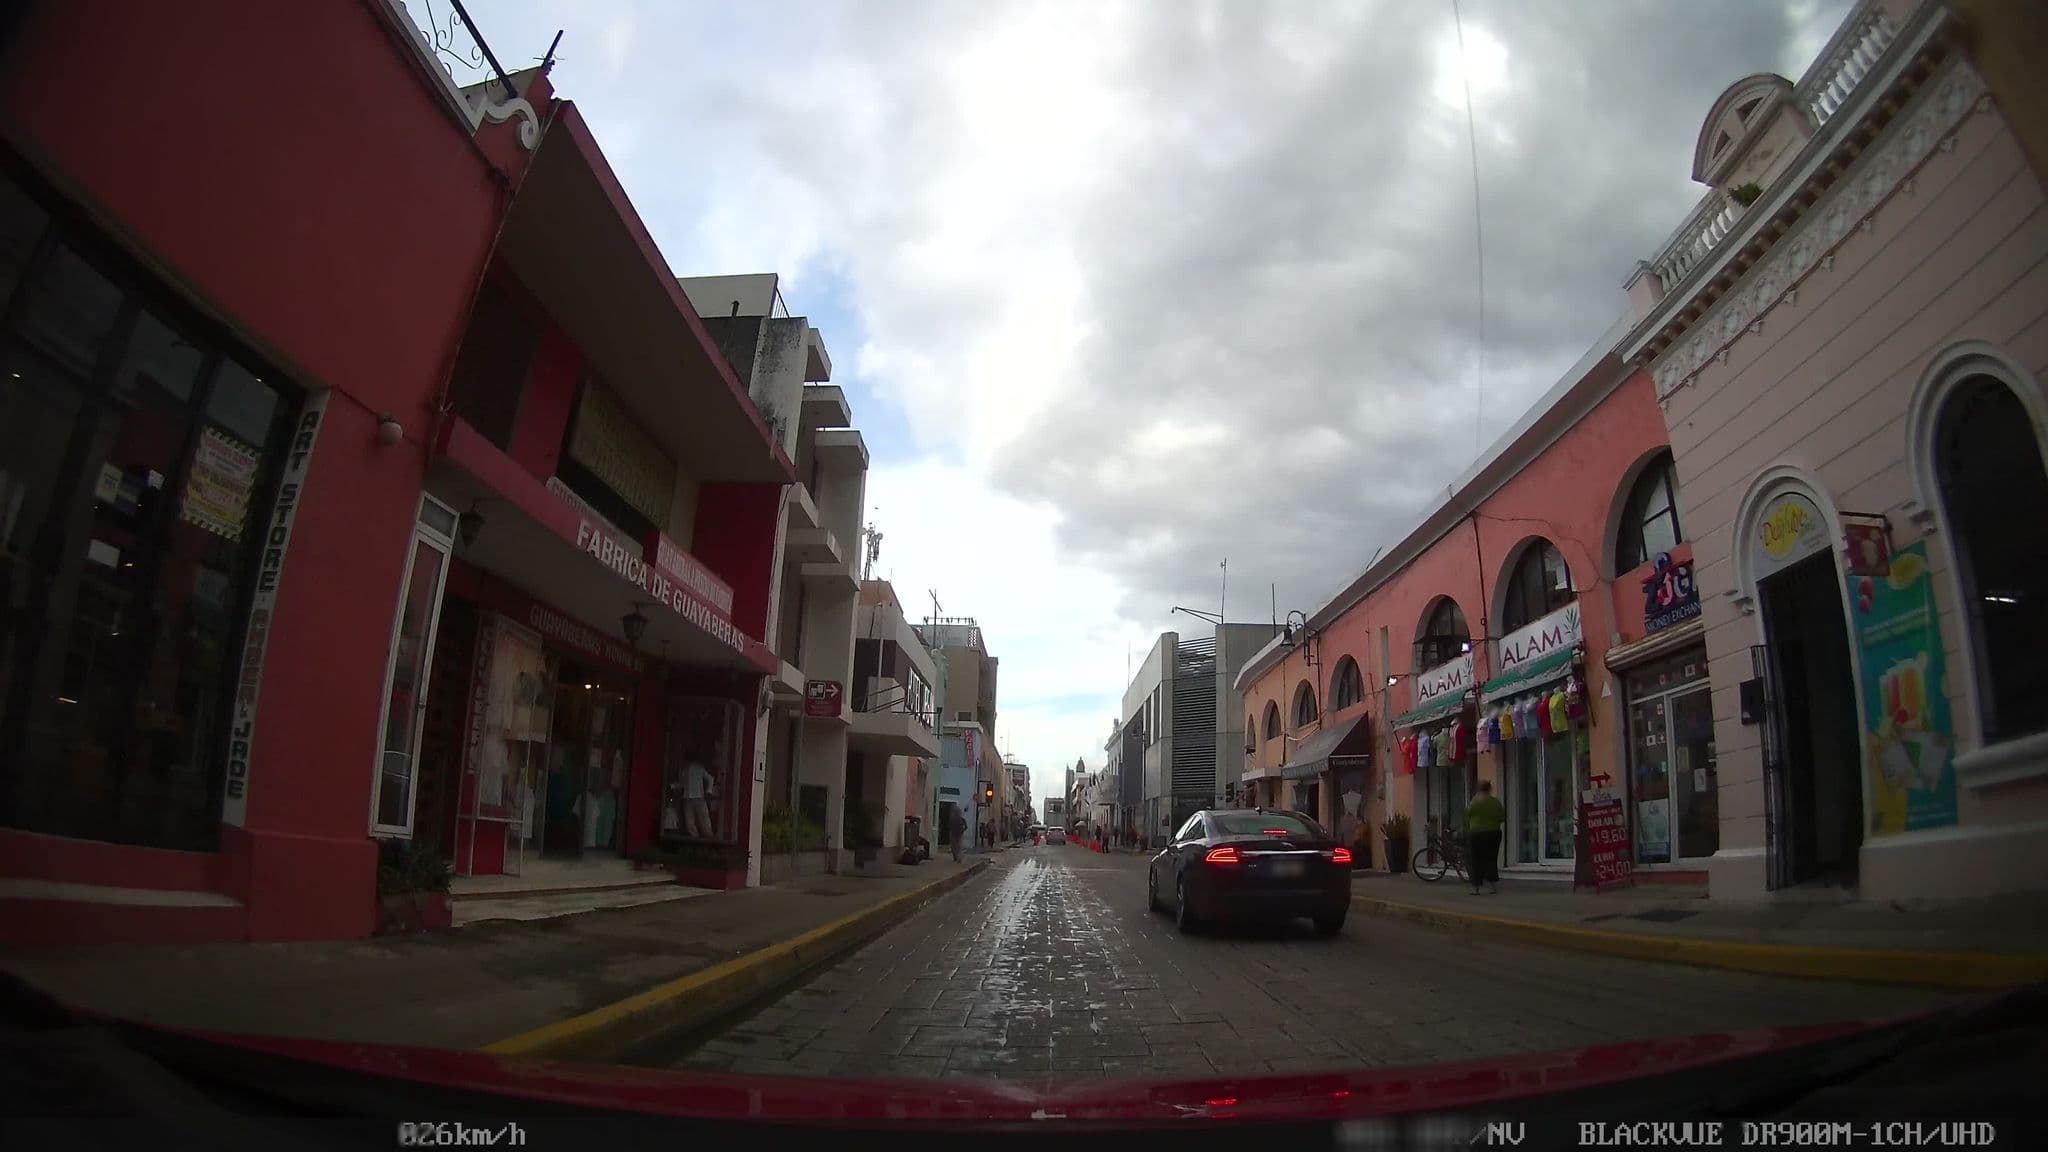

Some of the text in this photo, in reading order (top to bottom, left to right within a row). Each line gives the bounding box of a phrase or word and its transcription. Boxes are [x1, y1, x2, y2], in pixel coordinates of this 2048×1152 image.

[293, 411, 320, 472] ART
[259, 483, 298, 592] STORE
[576, 519, 648, 590] FABRICA
[652, 573, 671, 605] DE
[673, 589, 745, 653] GUAYABERAS
[1501, 624, 1564, 669] ALAM
[1647, 613, 1671, 633] MONEY
[1419, 668, 1463, 701] ALAM
[228, 721, 251, 799] JADE
[1588, 818, 1614, 829] DOLAR
